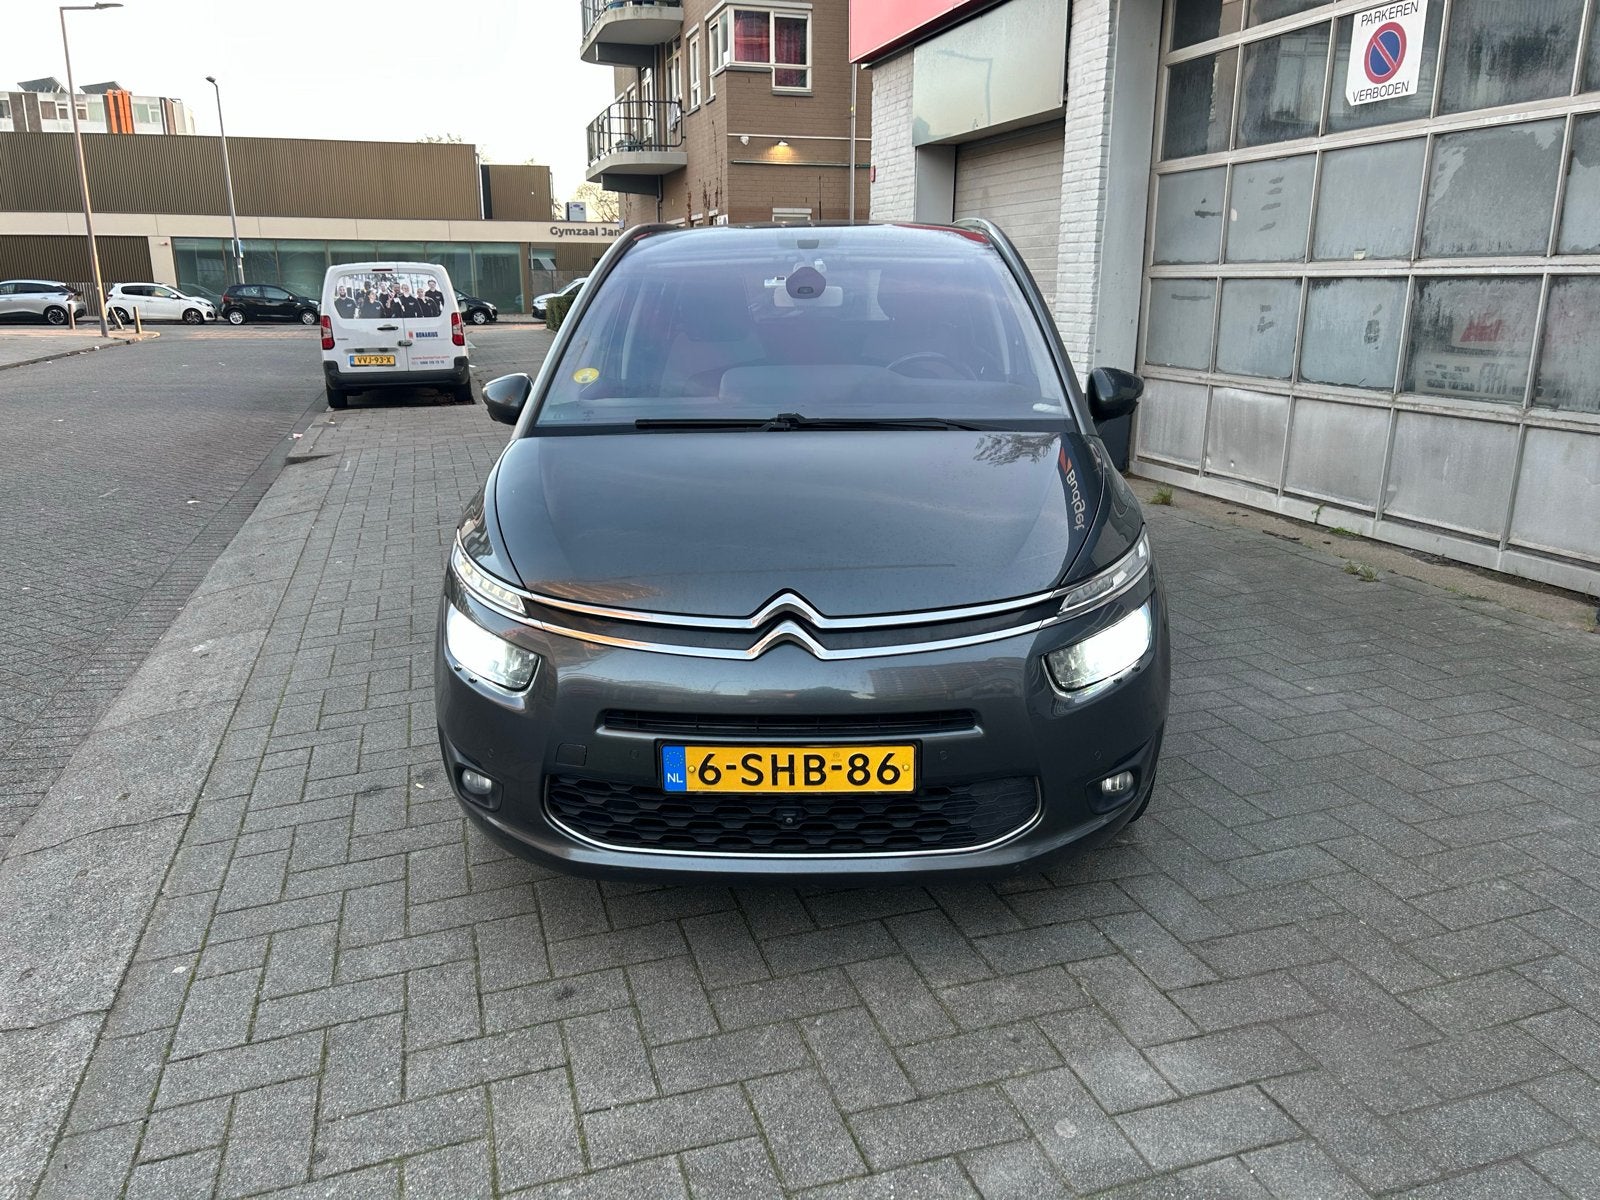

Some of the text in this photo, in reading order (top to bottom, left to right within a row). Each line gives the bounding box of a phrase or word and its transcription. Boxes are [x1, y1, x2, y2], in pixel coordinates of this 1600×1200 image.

[1361, 2, 1419, 27] PARKEREN
[1353, 81, 1410, 102] VERBODEN
[550, 226, 599, 237] Gymzaal
[667, 773, 683, 783] NL
[698, 753, 901, 787] 6-SHB-86
